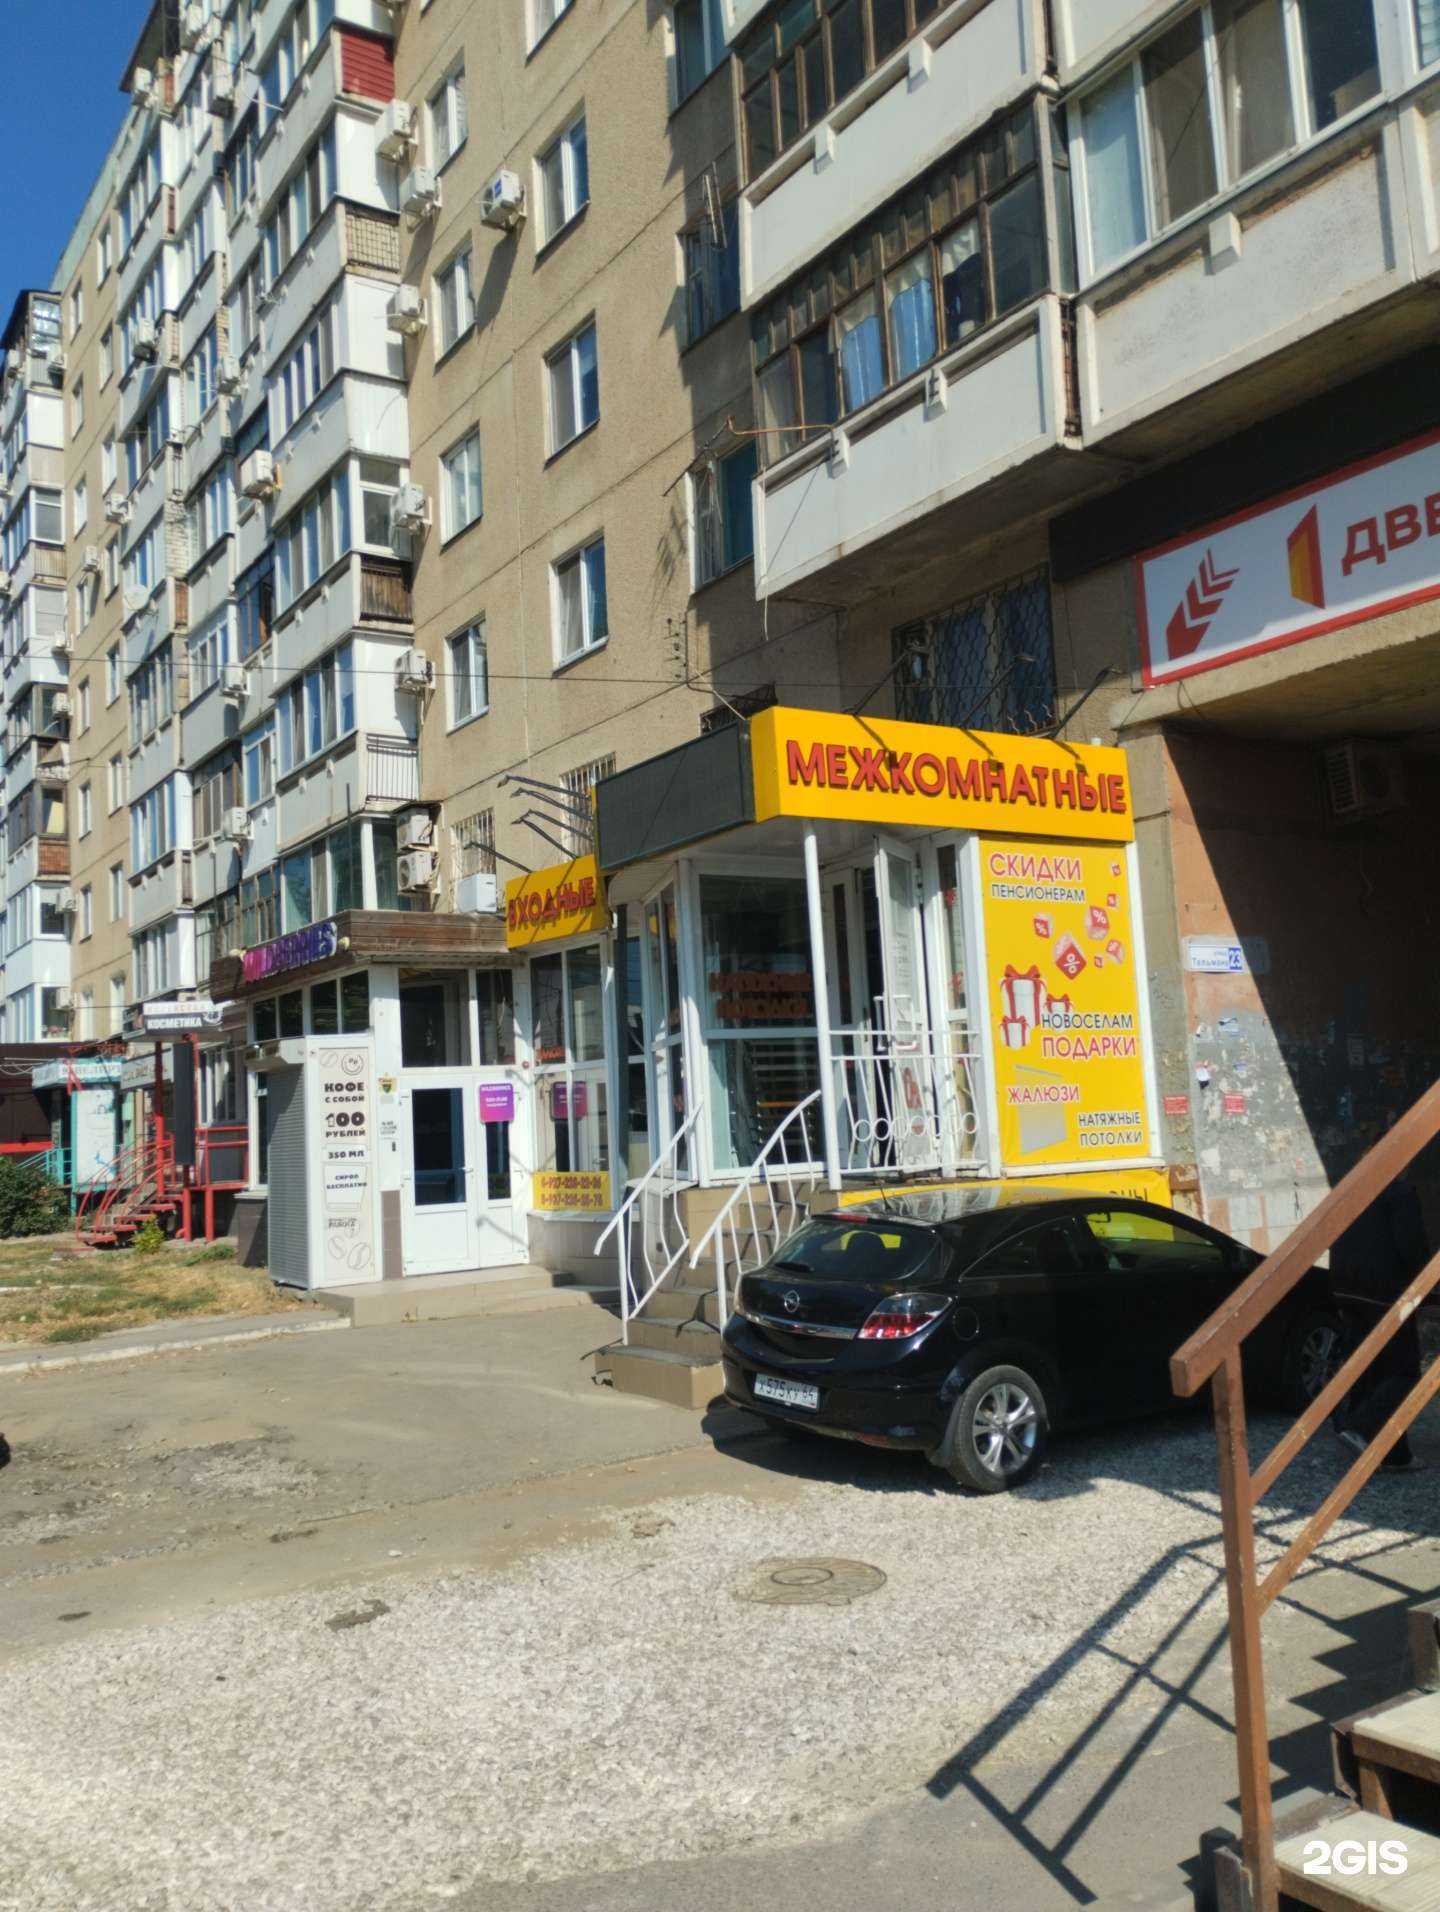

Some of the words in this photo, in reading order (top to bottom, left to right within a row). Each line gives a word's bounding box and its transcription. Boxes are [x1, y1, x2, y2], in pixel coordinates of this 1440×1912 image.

[786, 739, 1127, 813] МЕЖКОМНАТНЫЕ
[989, 853, 1081, 882] СКИДКИ
[991, 884, 1085, 902] ПЕНСИОНЕРАМ
[508, 876, 595, 931] ВХОДНЫЕ
[1041, 1013, 1133, 1030] НОВОСЕЛАМ
[1041, 1036, 1136, 1060] ПОДАРКИ
[324, 1082, 364, 1092] КОФЕ
[1007, 1086, 1080, 1103] ЖАЛЮЗИ
[325, 1111, 365, 1127] 100
[1078, 1112, 1141, 1127] НАТЯЖНЫЕ
[325, 1128, 366, 1138] РУБЛЕЙ
[1079, 1131, 1143, 1148] ПОТОЛКИ
[328, 1151, 346, 1159] 350
